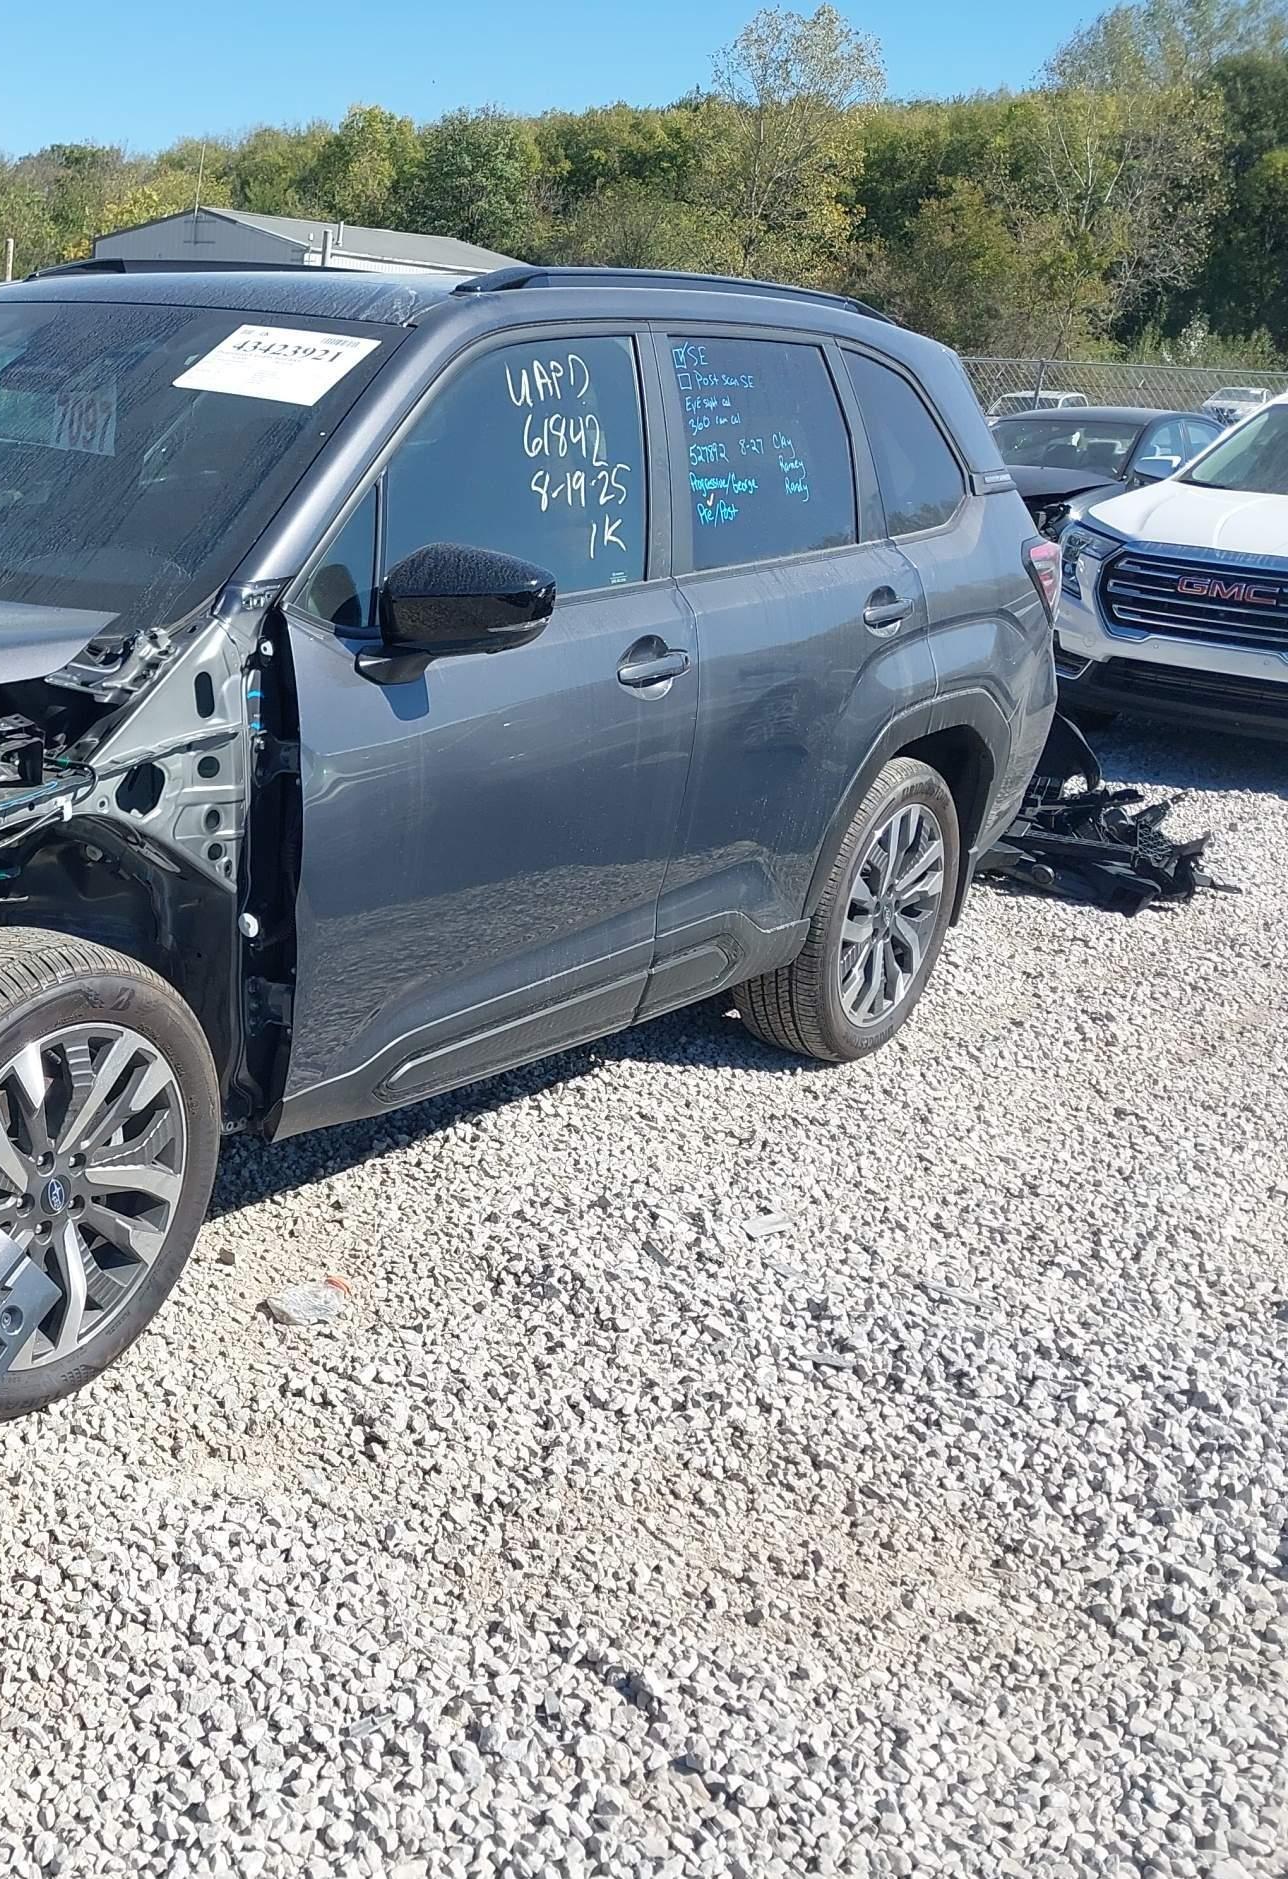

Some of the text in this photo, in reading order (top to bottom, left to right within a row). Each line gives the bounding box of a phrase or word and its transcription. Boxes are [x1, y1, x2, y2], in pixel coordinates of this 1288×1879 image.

[232, 339, 344, 363] 43423921
[687, 346, 709, 366] SE
[693, 370, 719, 390] Post
[688, 415, 710, 436] 360
[524, 413, 608, 467] 61842
[689, 442, 729, 466] 527892
[738, 438, 764, 455] 8-27
[1177, 576, 1281, 606] GMC
